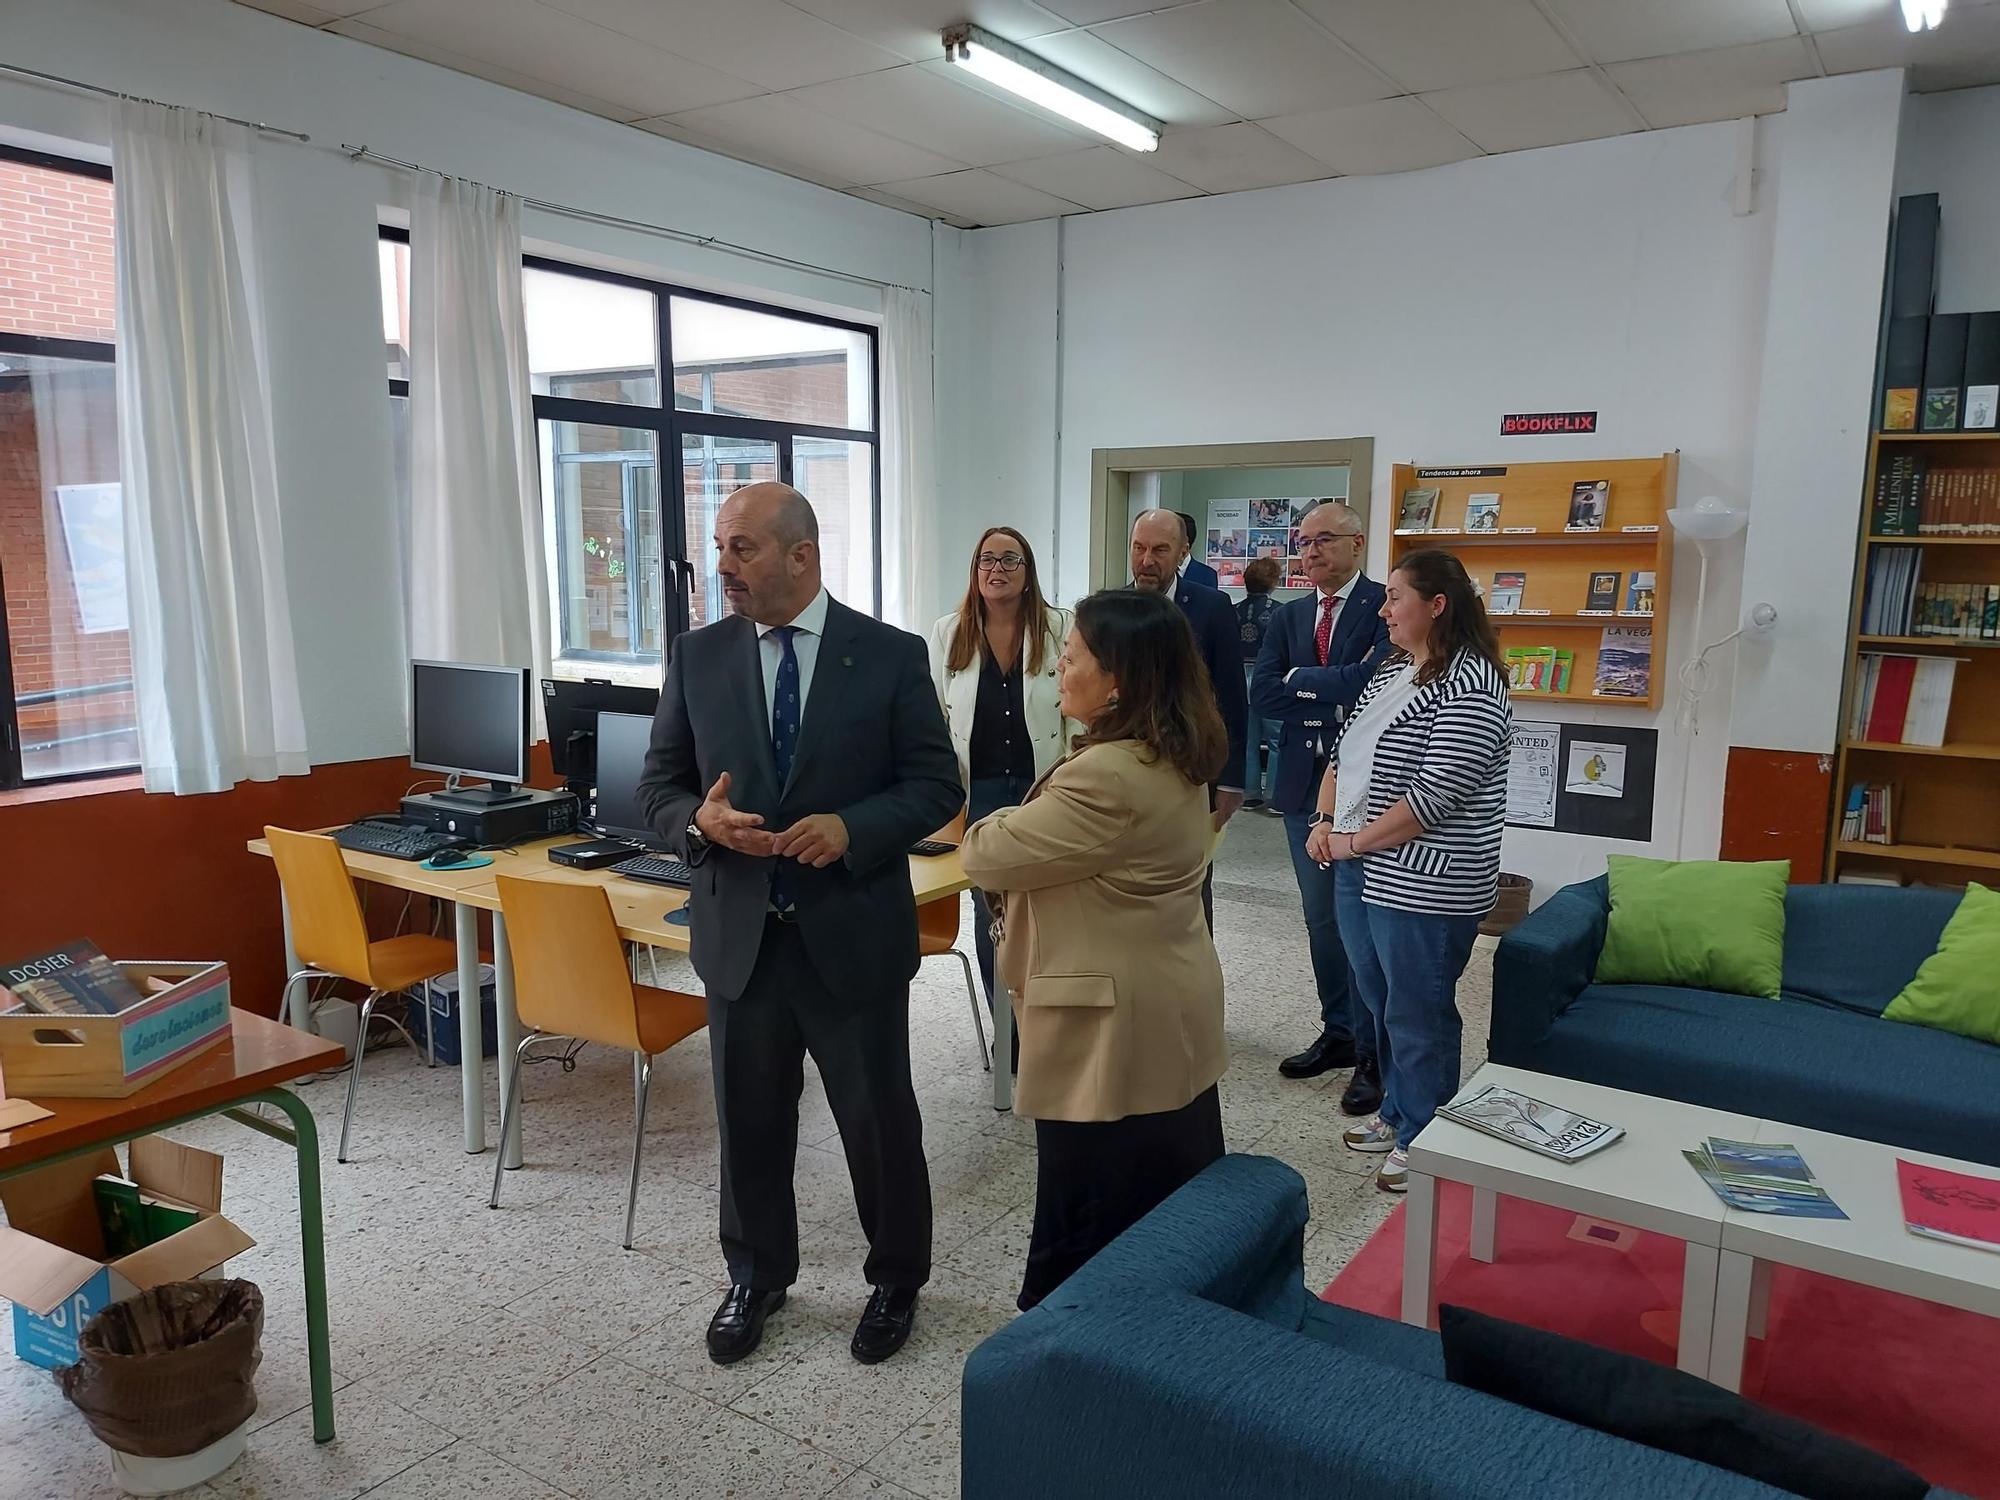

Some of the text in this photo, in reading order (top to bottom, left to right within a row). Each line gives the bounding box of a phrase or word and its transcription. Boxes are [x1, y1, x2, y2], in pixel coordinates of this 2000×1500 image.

[1504, 416, 1593, 432] BOOKFLIX
[1420, 468, 1481, 478] Tendencias ahora
[1883, 456, 1904, 525] MILLENIUM
[1607, 627, 1622, 636] LA
[1511, 737, 1549, 748] ANTED
[8, 953, 76, 983] DOSIER
[131, 1001, 224, 1056] devoluciones
